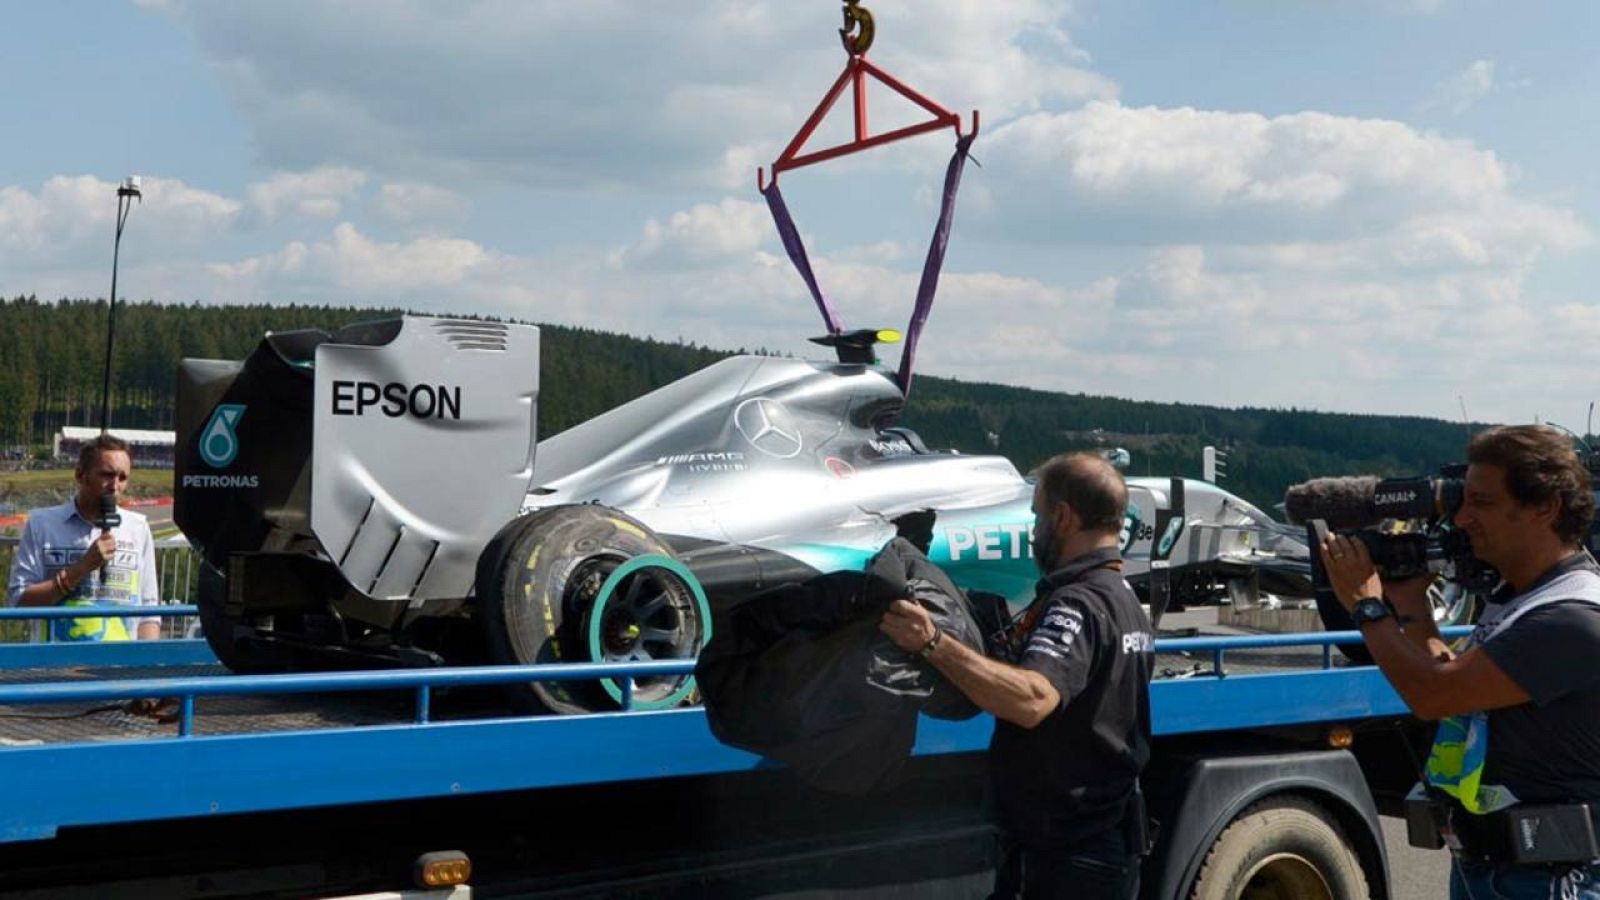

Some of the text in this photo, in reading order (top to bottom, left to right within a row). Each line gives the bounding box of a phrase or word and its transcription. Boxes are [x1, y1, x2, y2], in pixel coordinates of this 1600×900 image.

[332, 380, 461, 419] EPSON
[182, 474, 259, 488] PETRONAS
[1374, 490, 1417, 506] CANAL+
